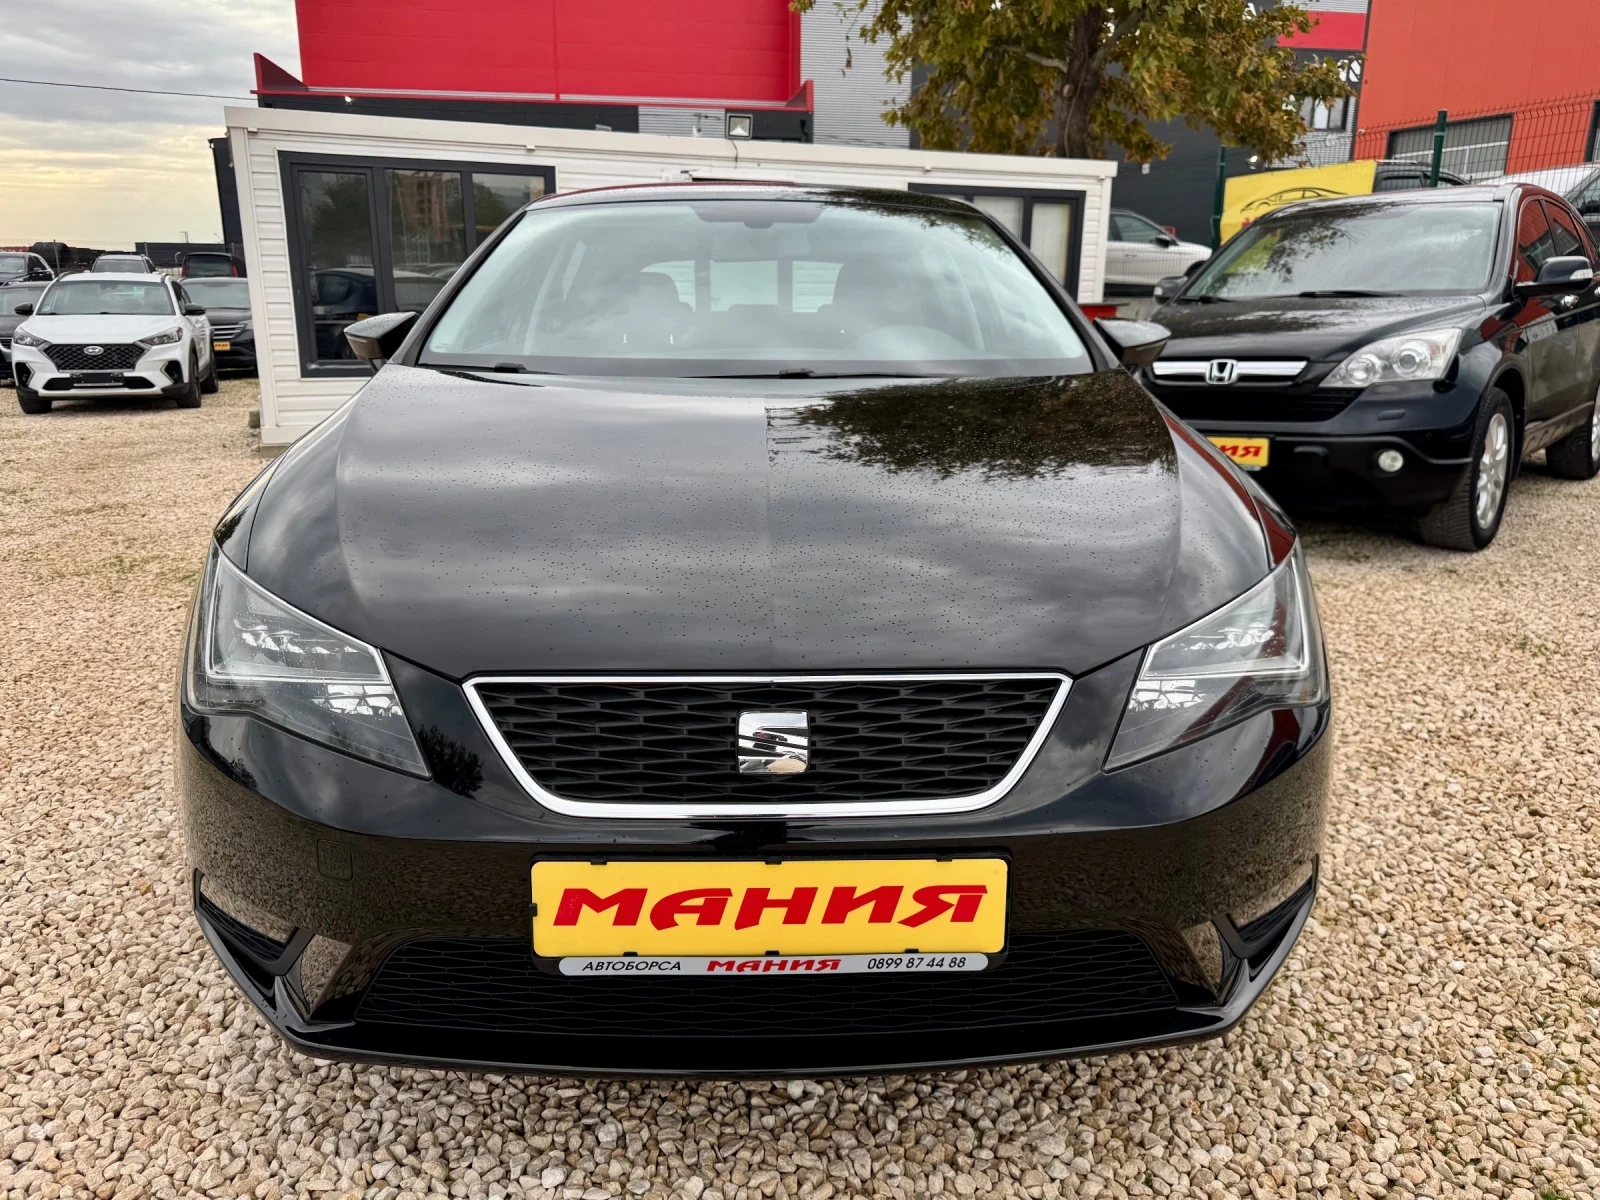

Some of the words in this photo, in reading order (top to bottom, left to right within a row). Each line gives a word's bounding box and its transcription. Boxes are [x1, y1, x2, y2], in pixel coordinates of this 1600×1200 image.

[552, 884, 989, 931] МАНИЯ
[581, 960, 682, 972] АВТОБОРСА
[706, 958, 842, 973] МАНИЯ
[867, 957, 903, 970] 0899
[905, 957, 925, 969] 87
[925, 956, 945, 969] 44
[948, 956, 967, 969] 88
